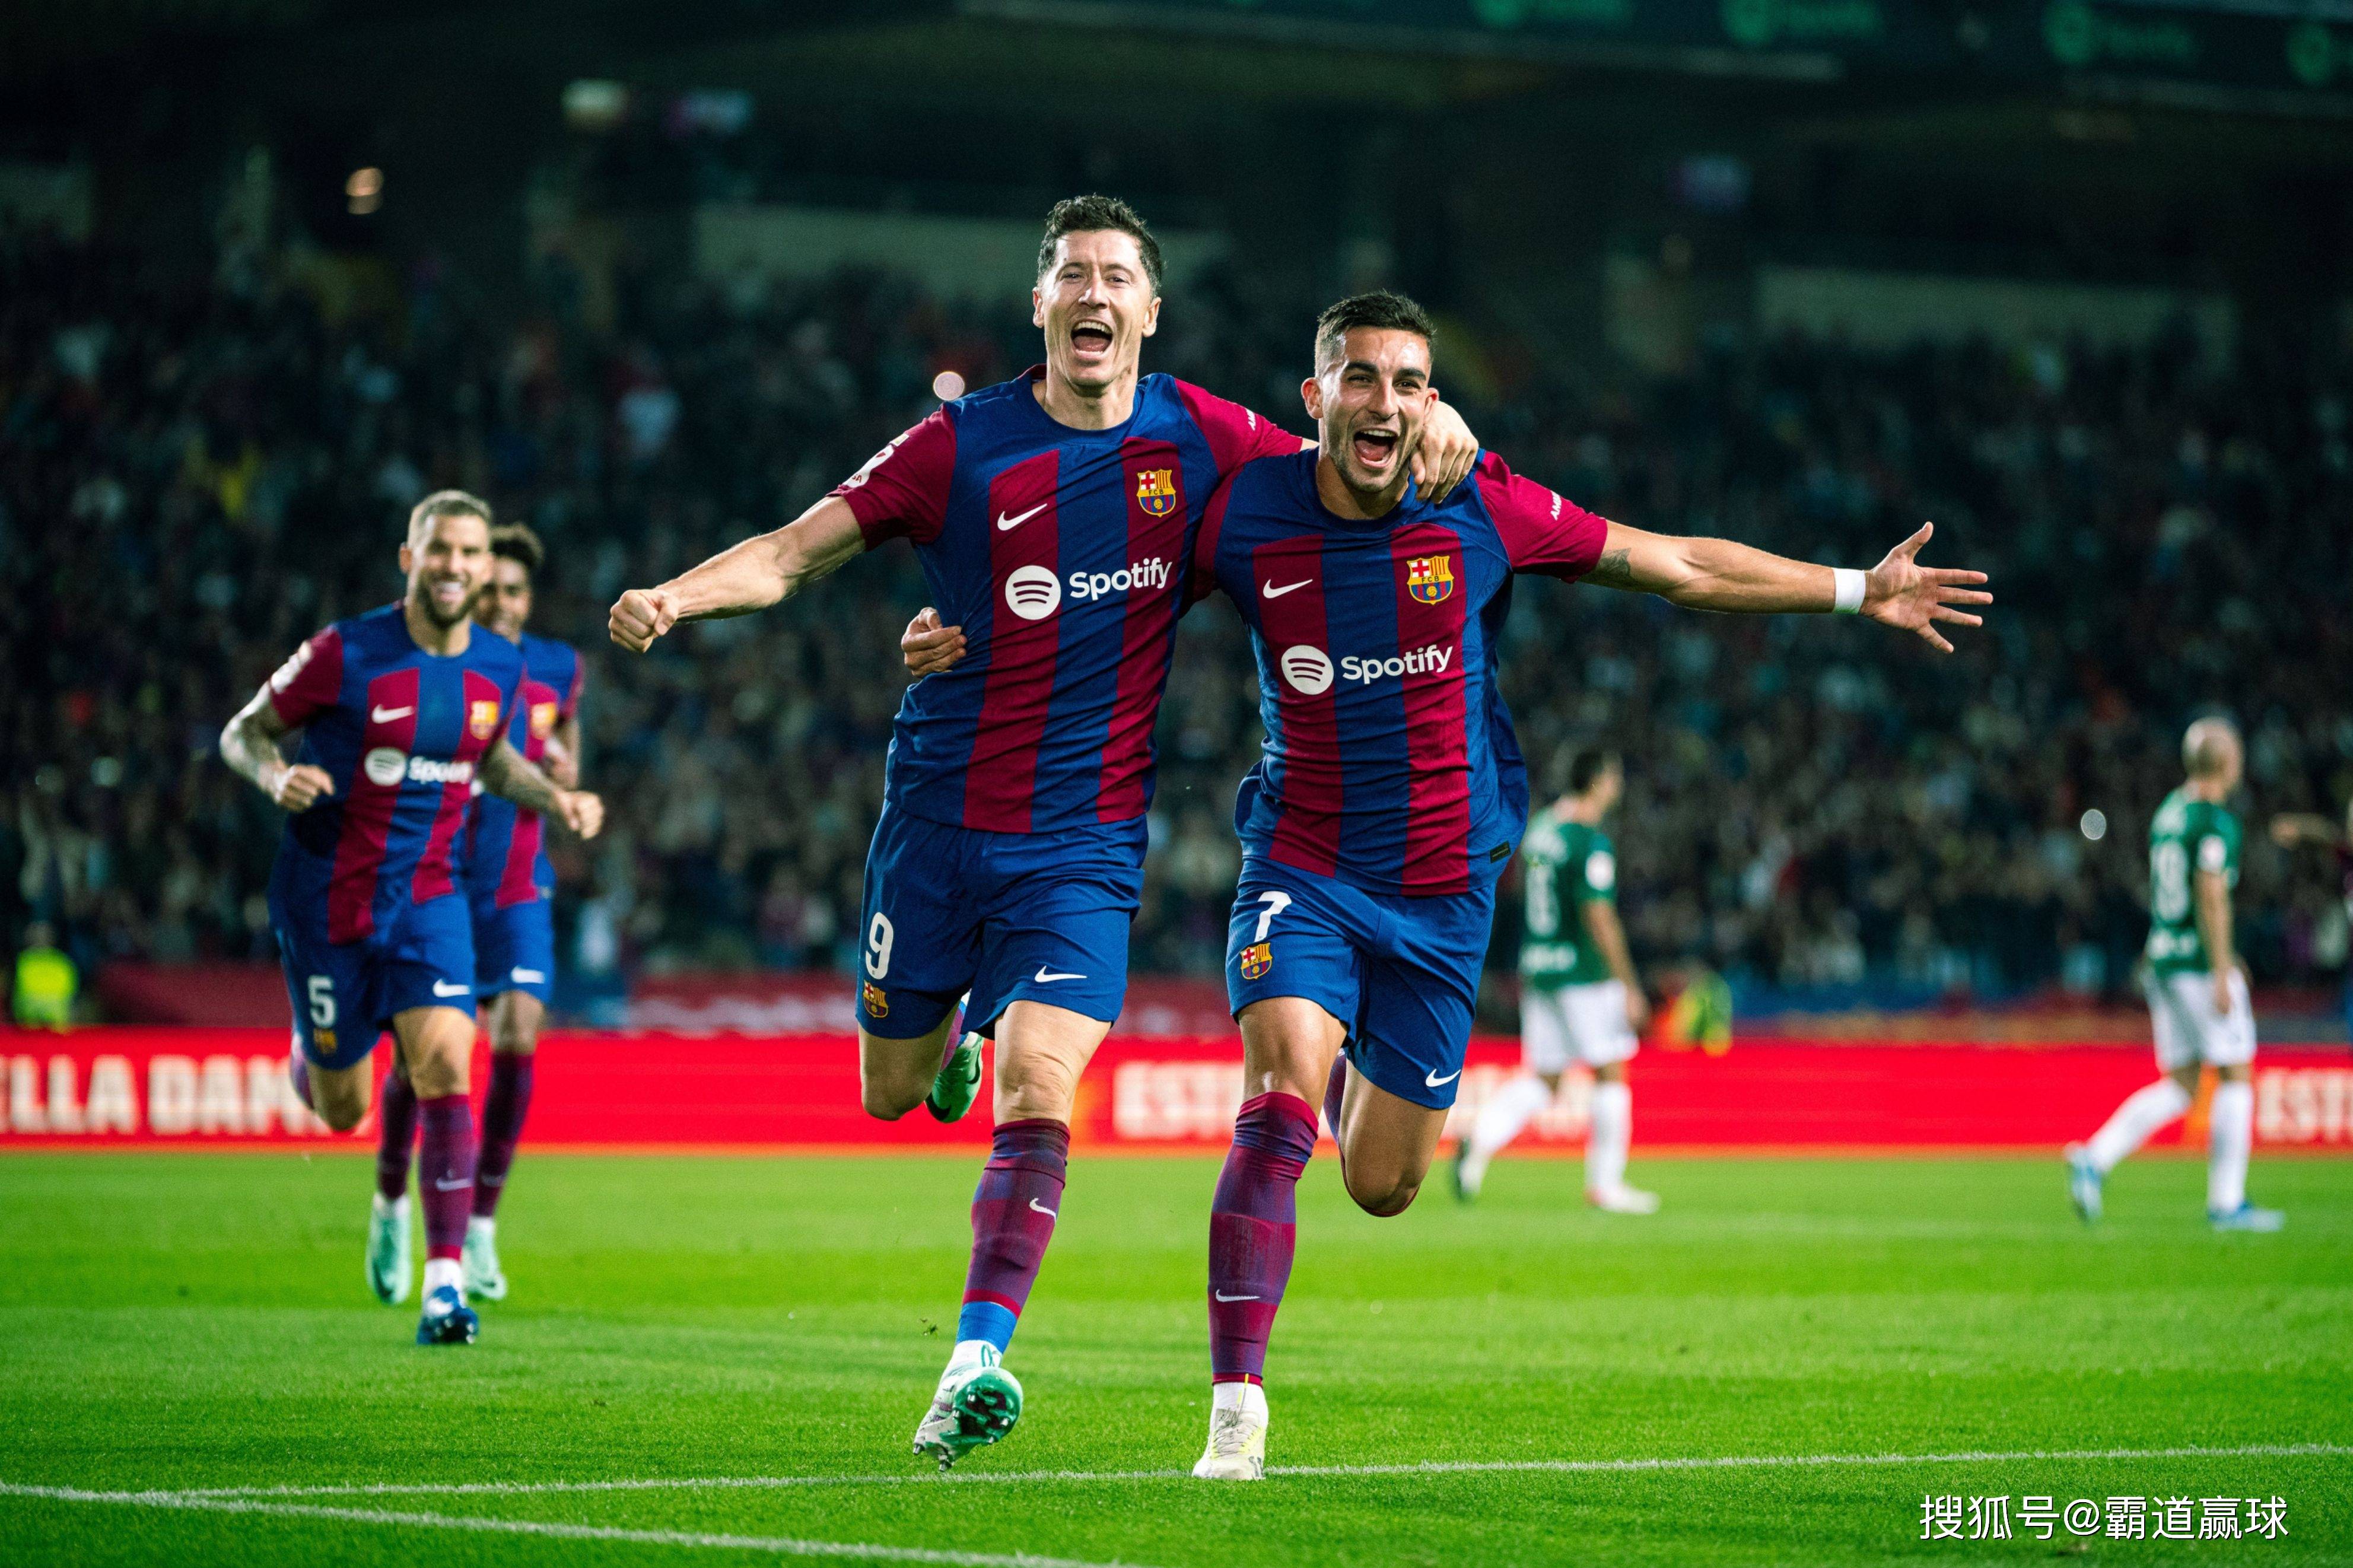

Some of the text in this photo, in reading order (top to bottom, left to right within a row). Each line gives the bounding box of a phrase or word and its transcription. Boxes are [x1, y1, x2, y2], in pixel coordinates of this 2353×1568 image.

[1069, 557, 1173, 602] Spotify
[1341, 644, 1454, 685] Spotify
[1254, 890, 1292, 943] 7
[866, 912, 894, 979] 9
[308, 975, 336, 1028] 5
[0, 1054, 372, 1135] LLA DAM
